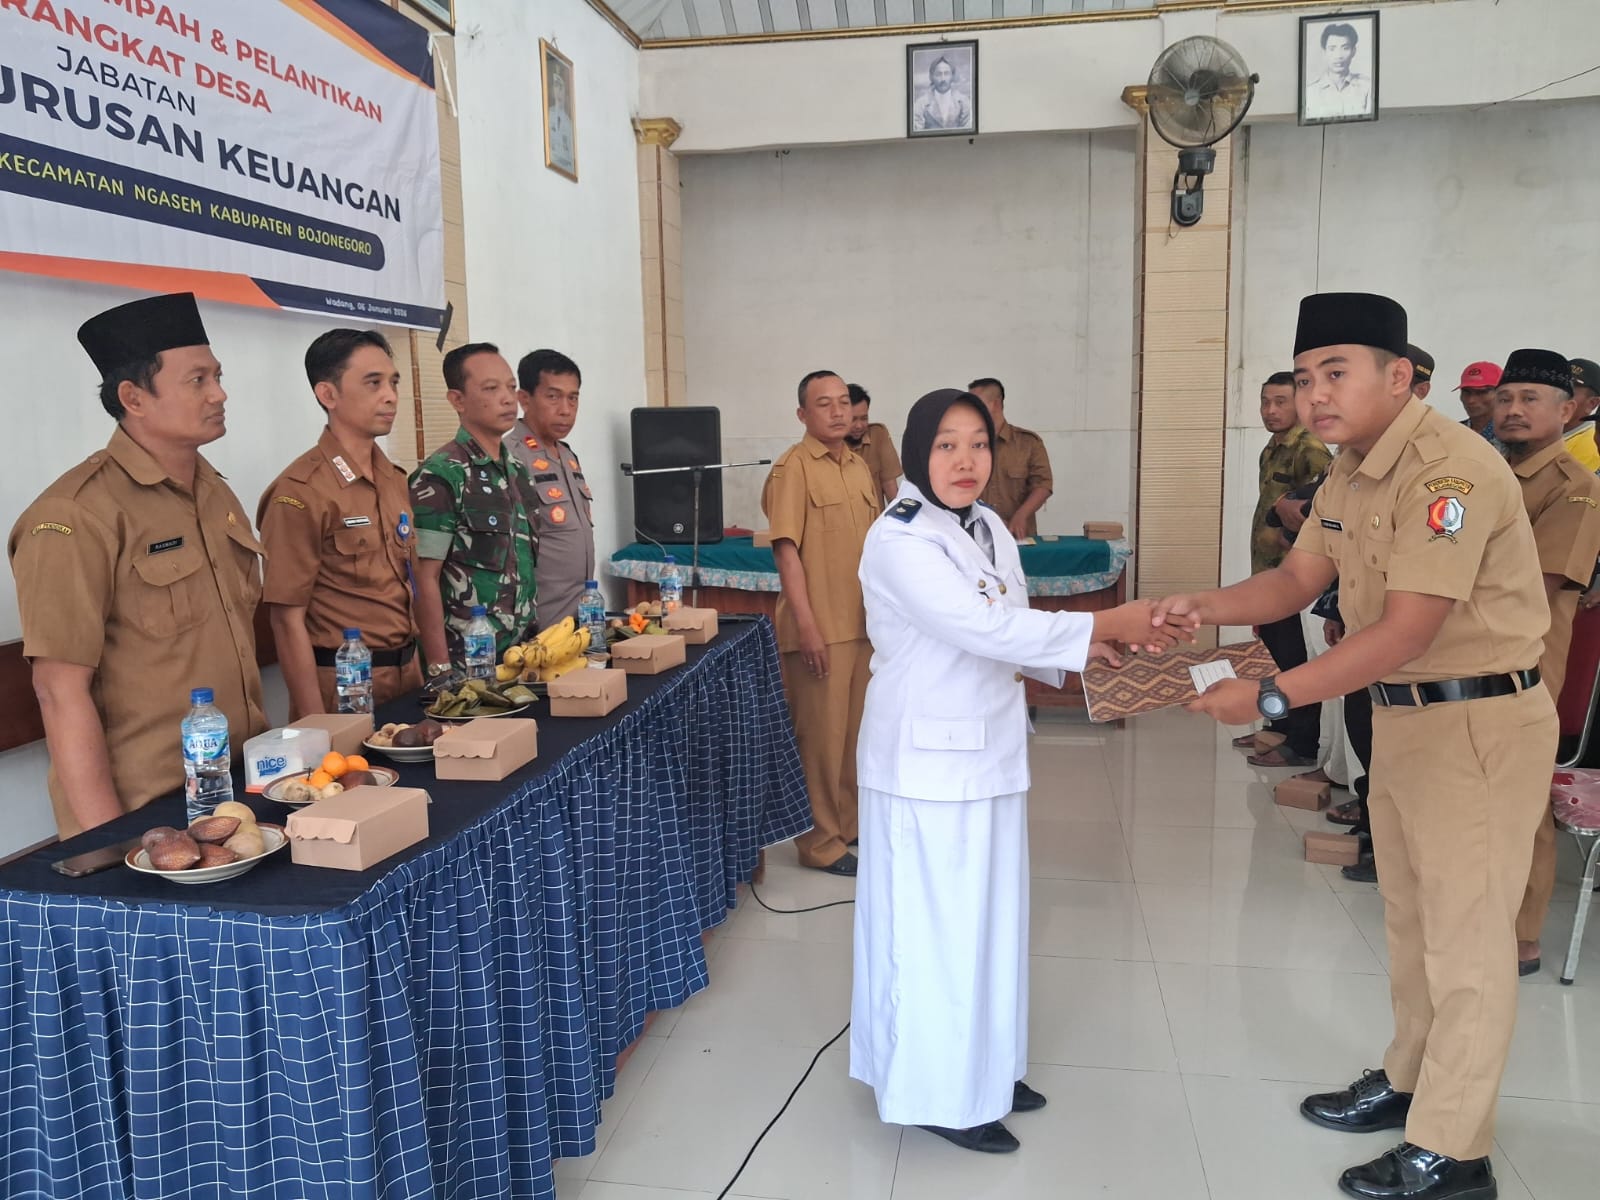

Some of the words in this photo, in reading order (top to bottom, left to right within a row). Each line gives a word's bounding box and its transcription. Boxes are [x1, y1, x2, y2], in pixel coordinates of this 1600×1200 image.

[57, 45, 196, 115] JABATAN
[195, 62, 272, 113] DESA
[210, 29, 228, 54] &
[236, 39, 382, 123] PELANTIKAN
[0, 152, 124, 196] KECAMATAN
[134, 184, 202, 214] NGASEM
[210, 203, 292, 237] KABUPATEN
[298, 225, 372, 256] BOJONEGORO
[217, 138, 402, 222] KEUANGAN
[256, 756, 287, 770] nice
